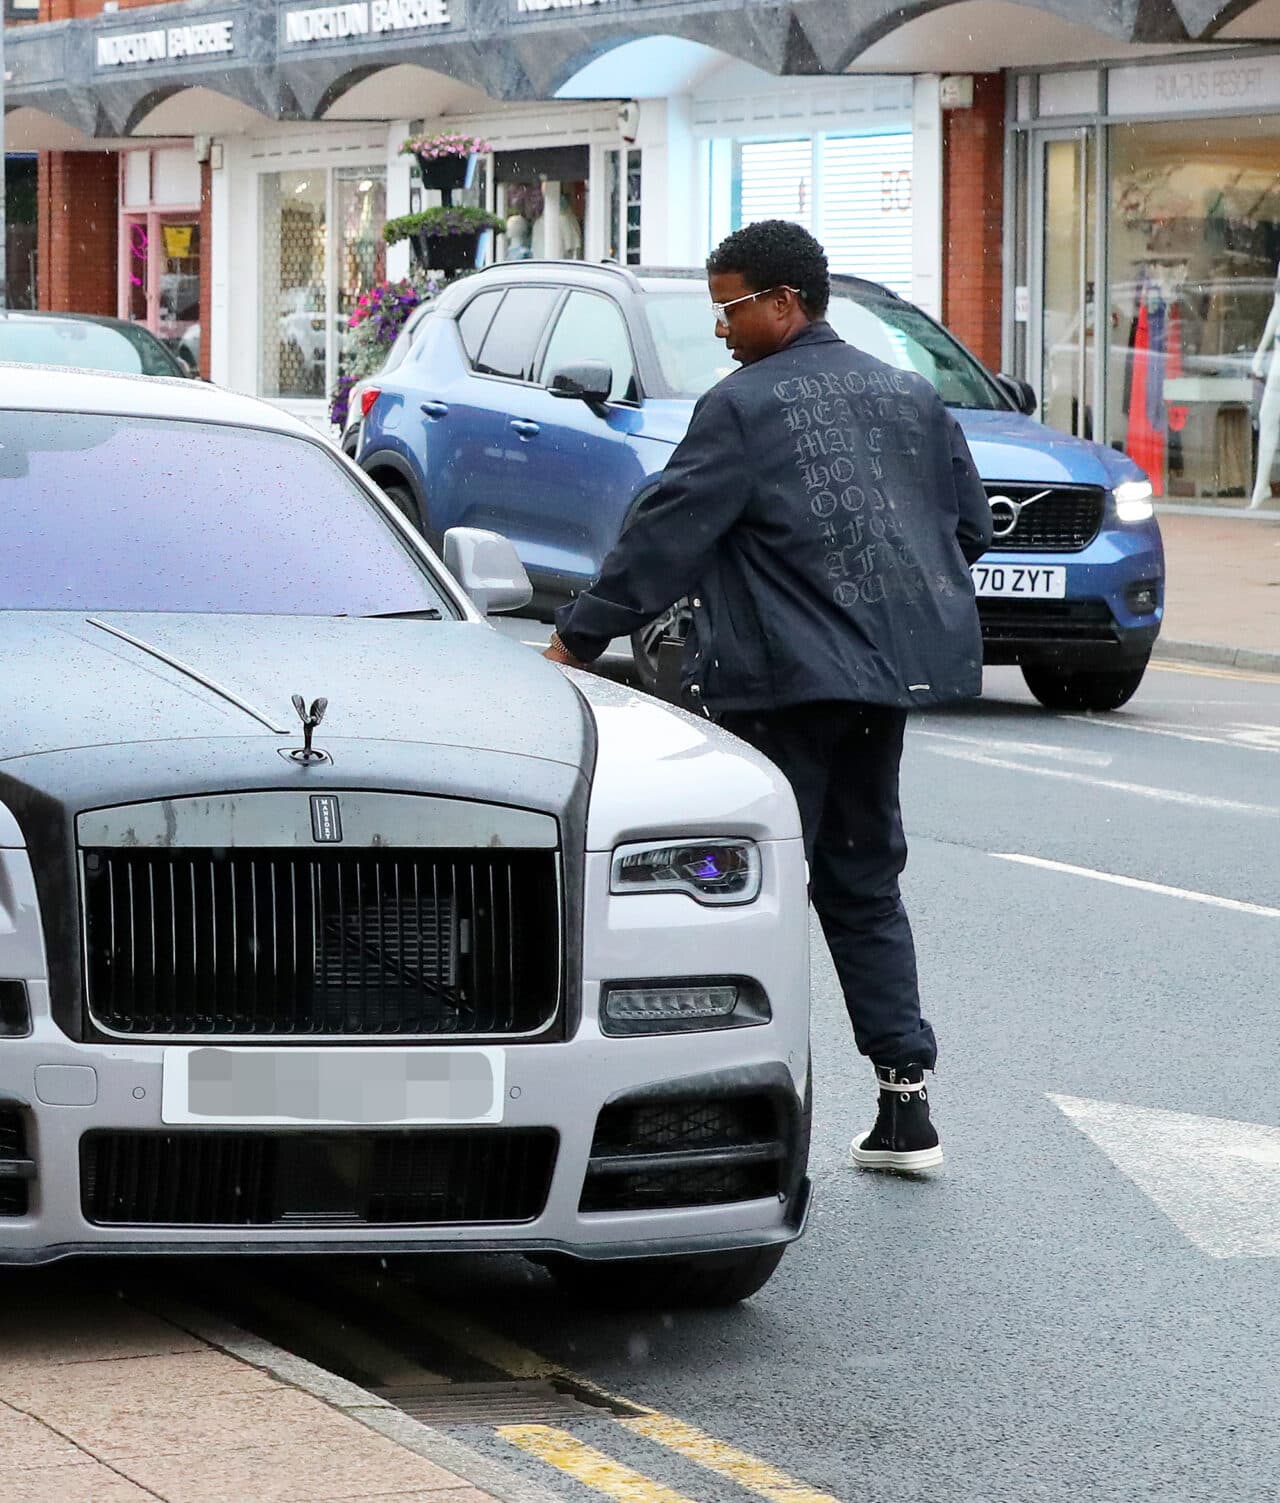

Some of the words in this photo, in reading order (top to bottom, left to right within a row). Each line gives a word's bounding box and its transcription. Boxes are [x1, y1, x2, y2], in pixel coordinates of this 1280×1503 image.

[286, 3, 369, 42] NORTON
[372, 0, 451, 32] BARRIE
[98, 30, 166, 65] NORTON
[168, 21, 234, 57] BARRIE
[773, 371, 911, 402] CHROME
[971, 568, 1005, 591] 70
[1011, 569, 1055, 593] ZYT
